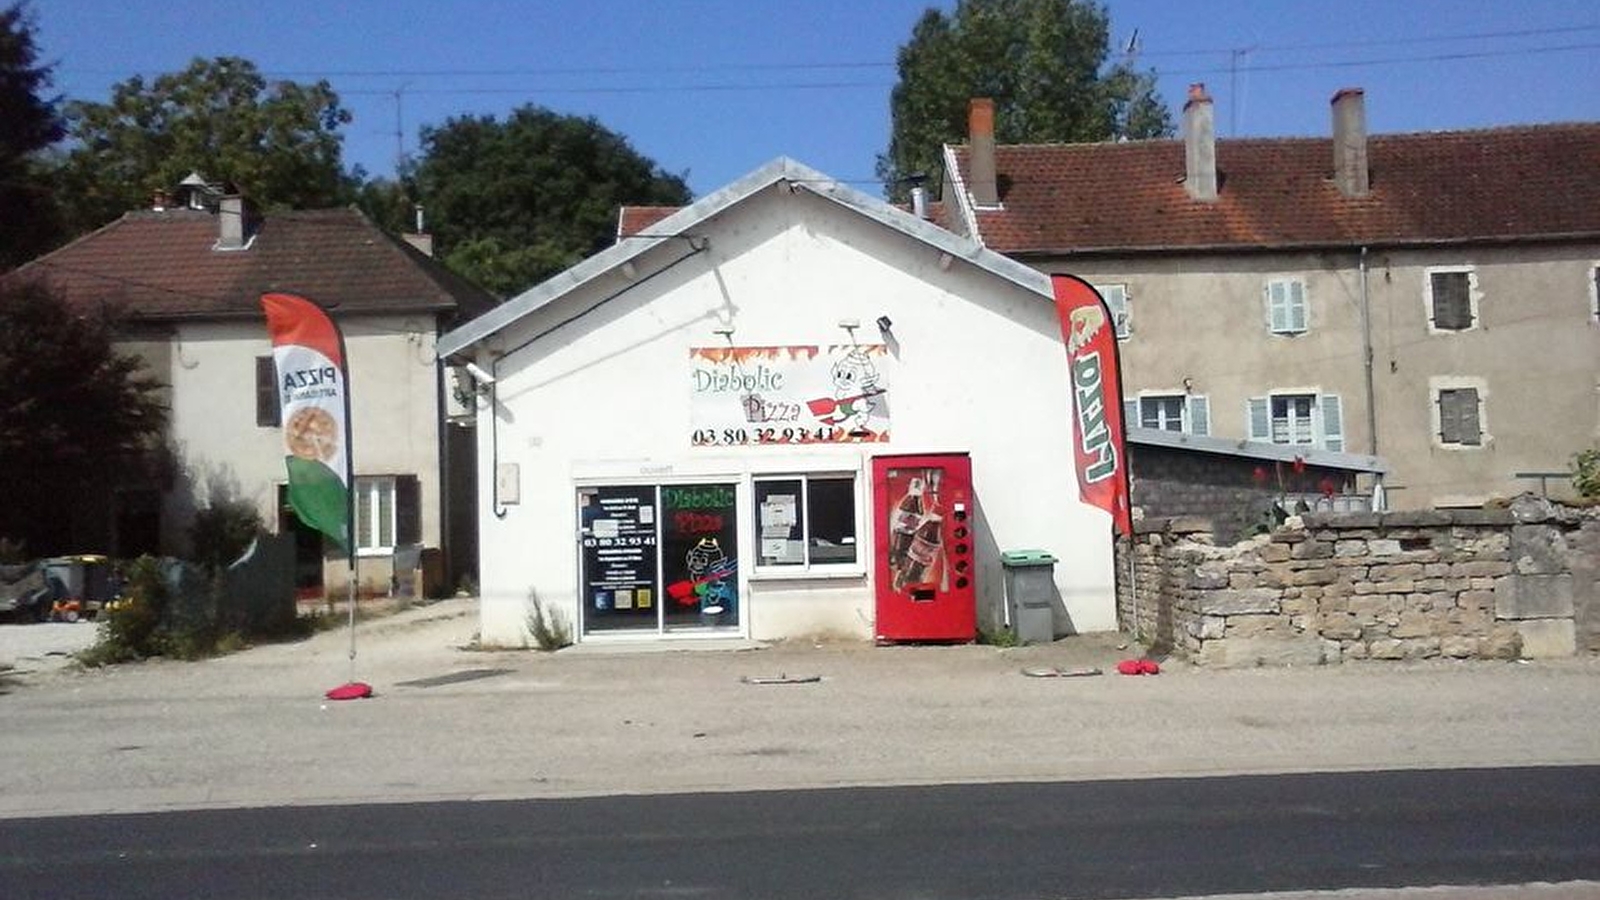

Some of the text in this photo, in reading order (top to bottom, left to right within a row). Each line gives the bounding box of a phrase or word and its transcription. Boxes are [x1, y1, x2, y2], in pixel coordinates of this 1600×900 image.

[692, 365, 783, 393] Diabolic
[743, 394, 800, 423] Pizza
[693, 427, 834, 445] 03 80 32 93 41
